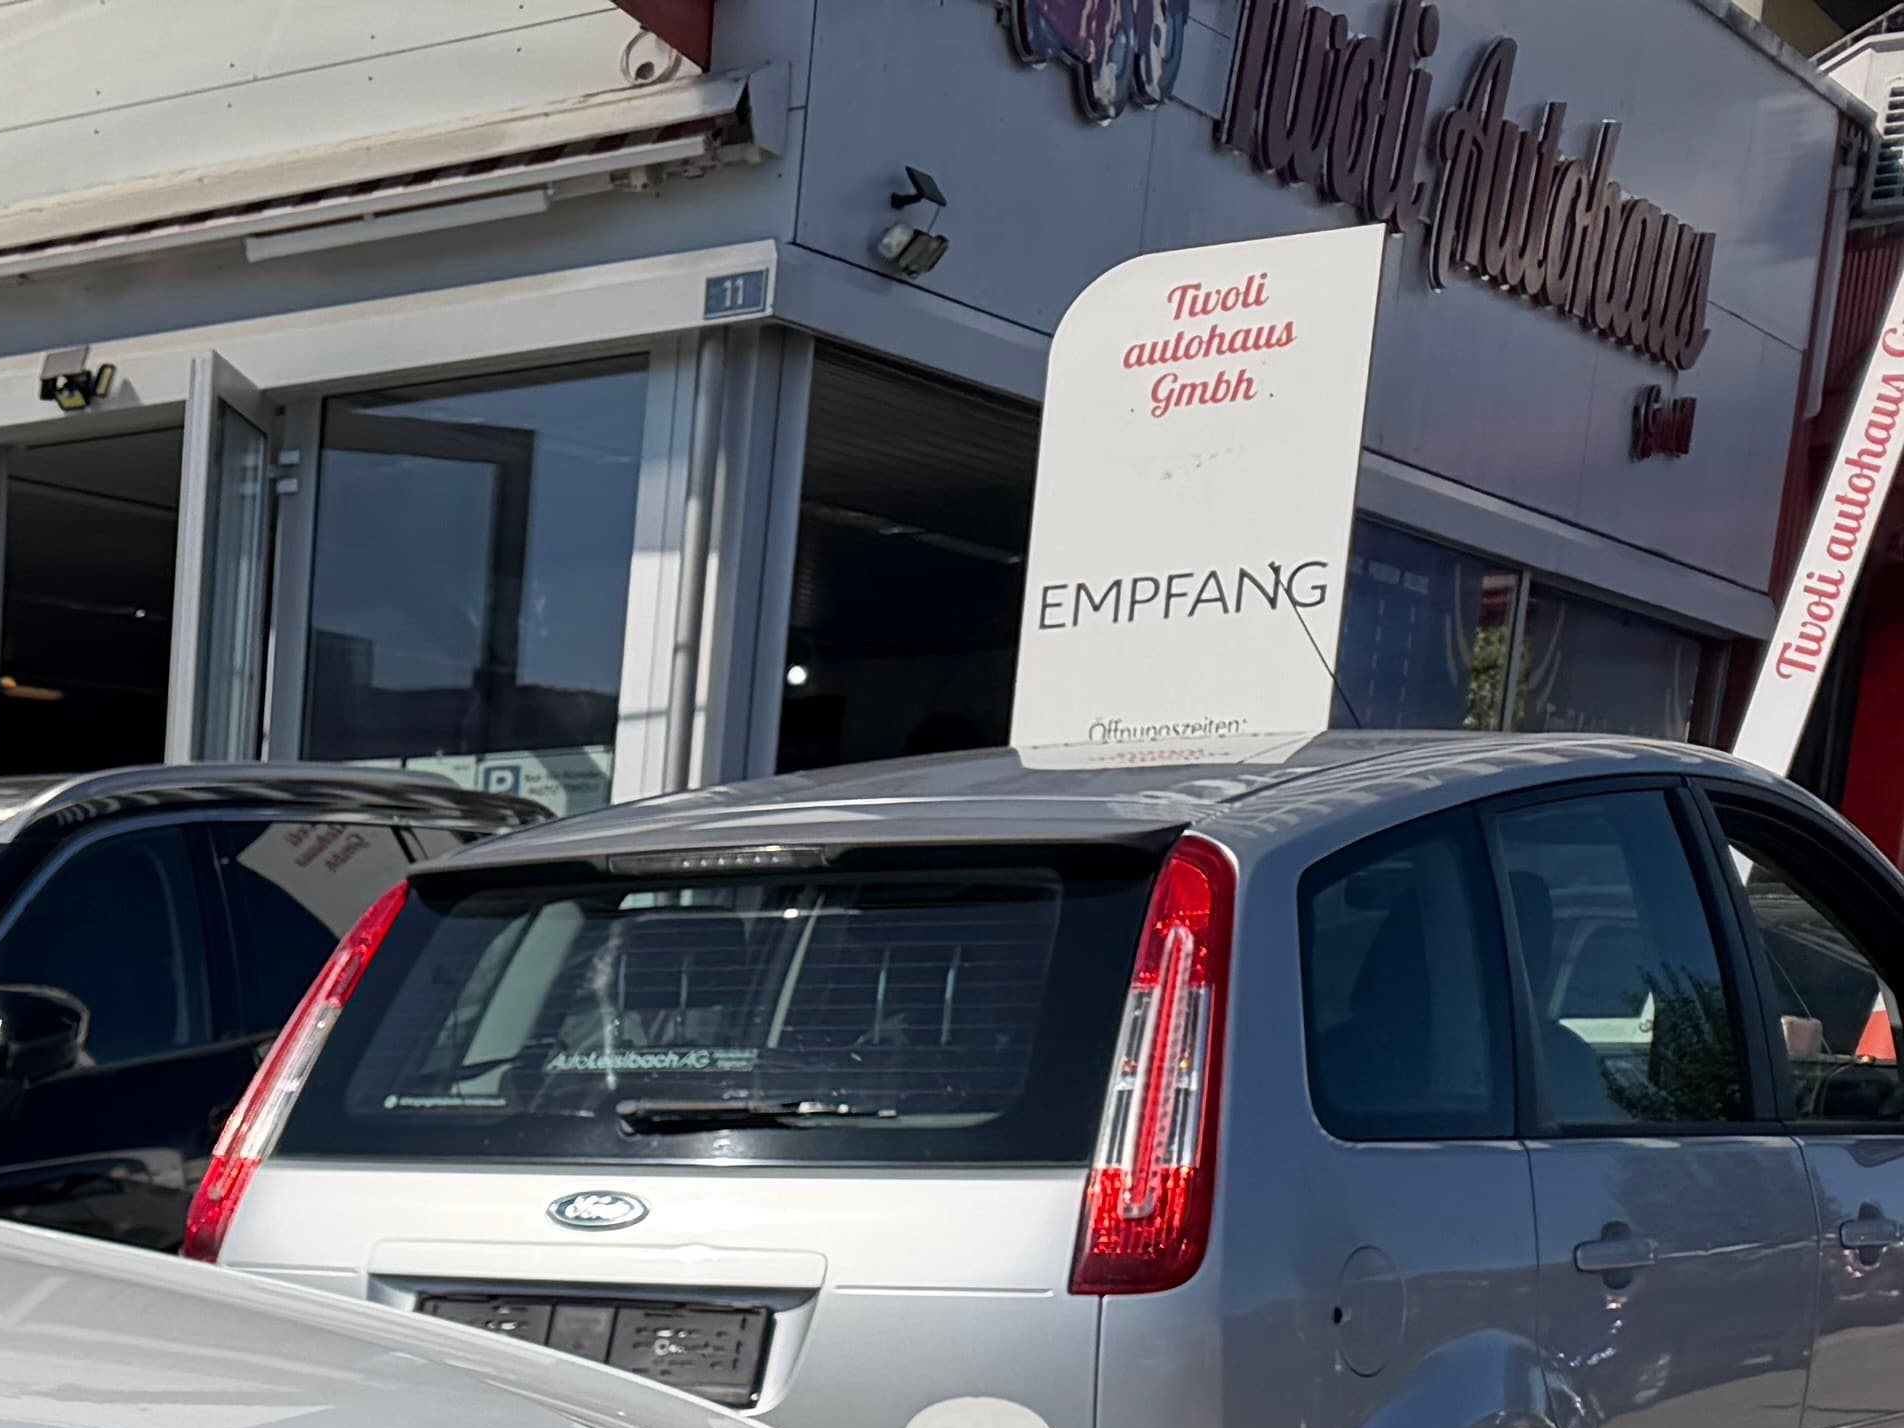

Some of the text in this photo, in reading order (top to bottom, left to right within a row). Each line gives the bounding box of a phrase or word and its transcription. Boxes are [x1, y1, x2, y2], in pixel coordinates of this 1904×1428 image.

[1427, 37, 1717, 371] Autohaus
[723, 277, 744, 307] 11
[1167, 272, 1268, 321] Tivoli
[1123, 320, 1297, 369] autohaus
[1151, 369, 1257, 418] Gmbh
[1775, 373, 1904, 681] Tivoli autohaus
[1038, 560, 1328, 630] EMPFANG
